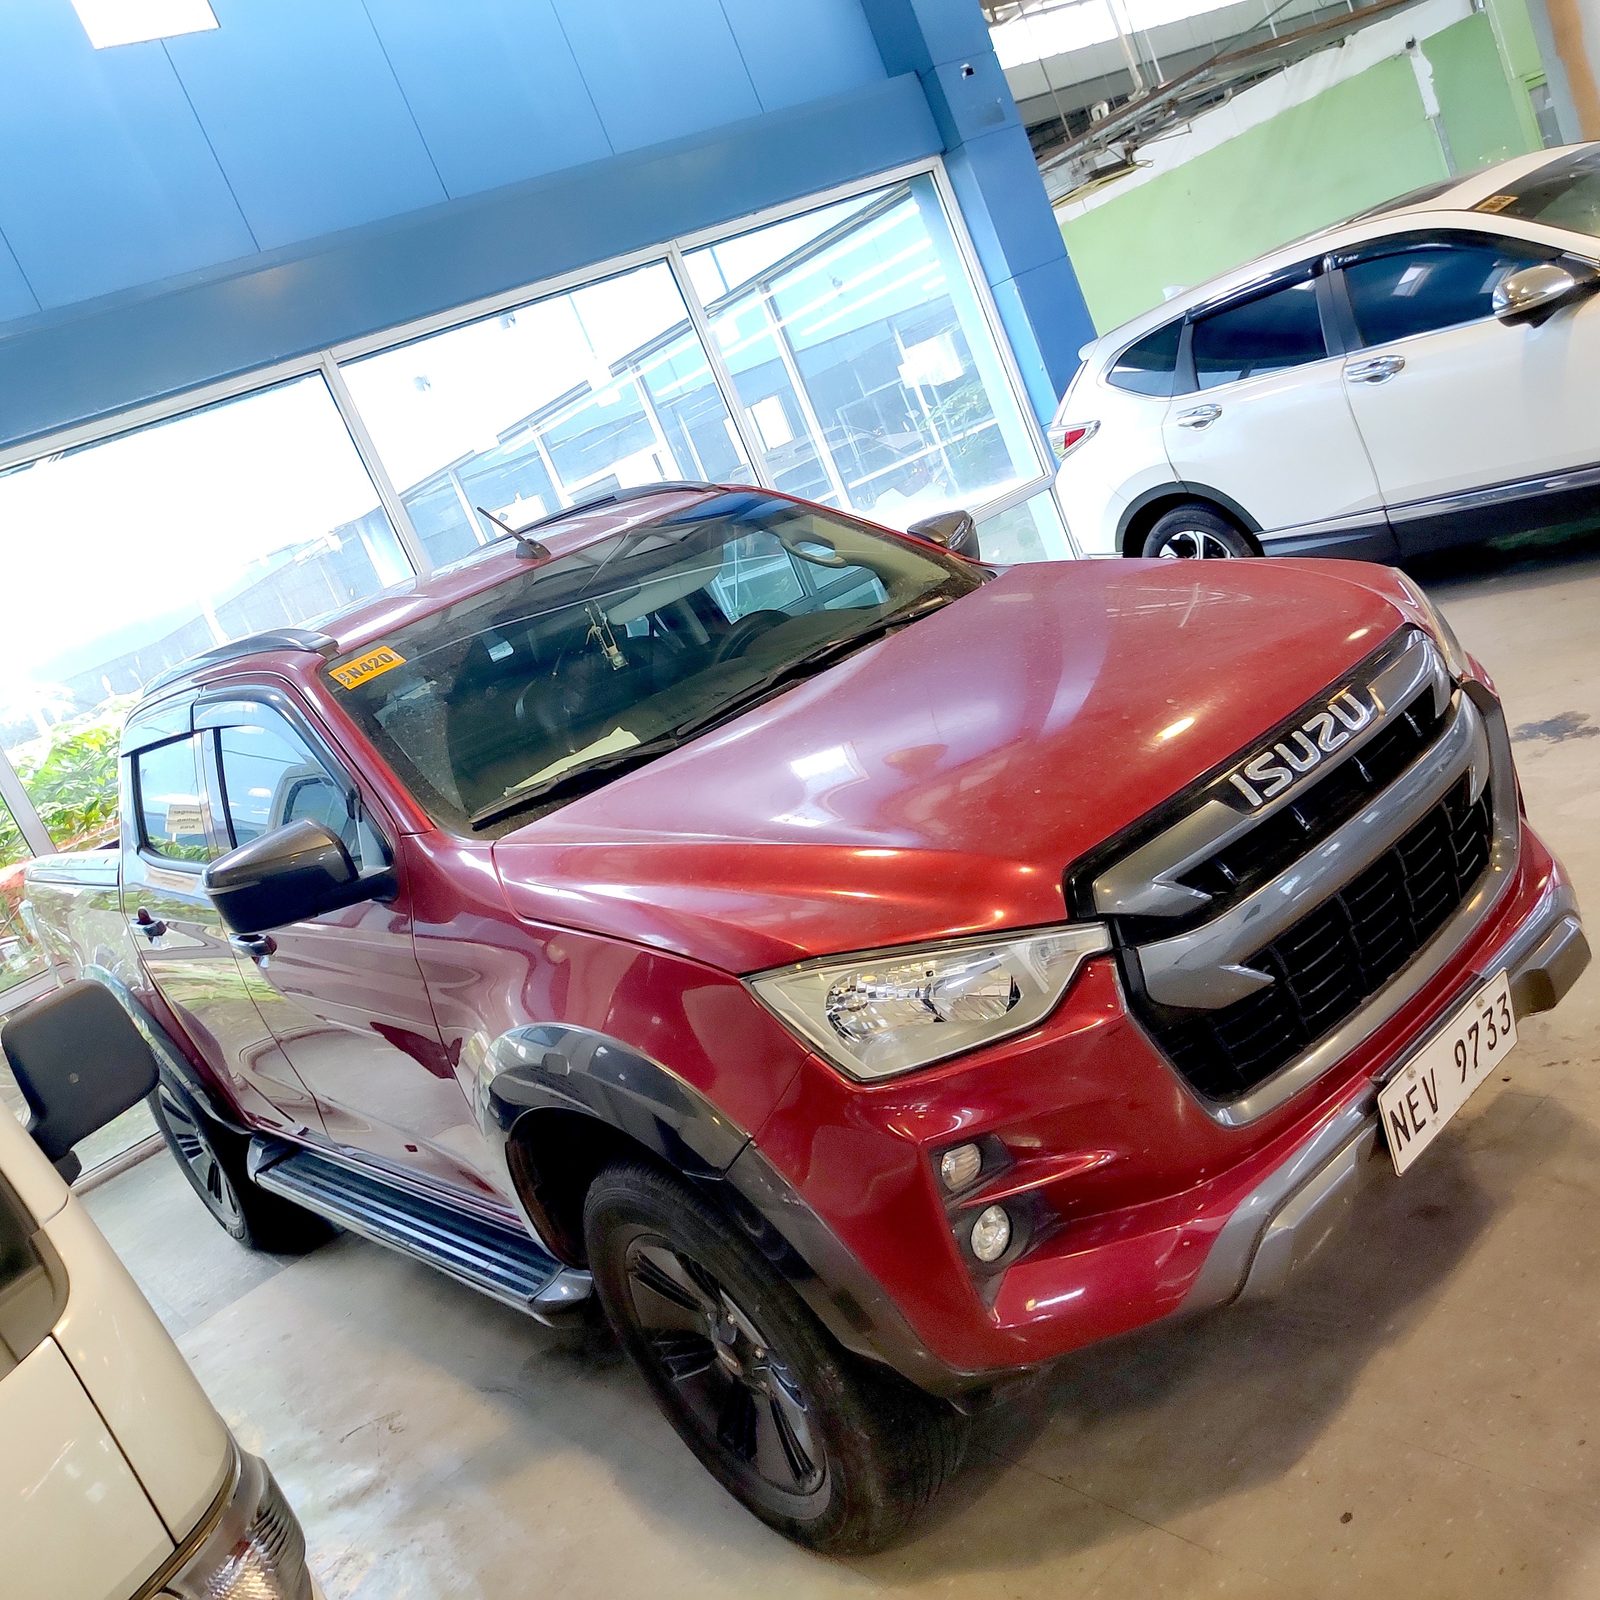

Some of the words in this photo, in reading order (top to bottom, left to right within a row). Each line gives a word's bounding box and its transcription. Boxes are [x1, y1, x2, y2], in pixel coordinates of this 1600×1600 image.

[1228, 693, 1371, 807] ISUZU
[1389, 1067, 1439, 1152] NEV
[1454, 991, 1511, 1085] 9733
